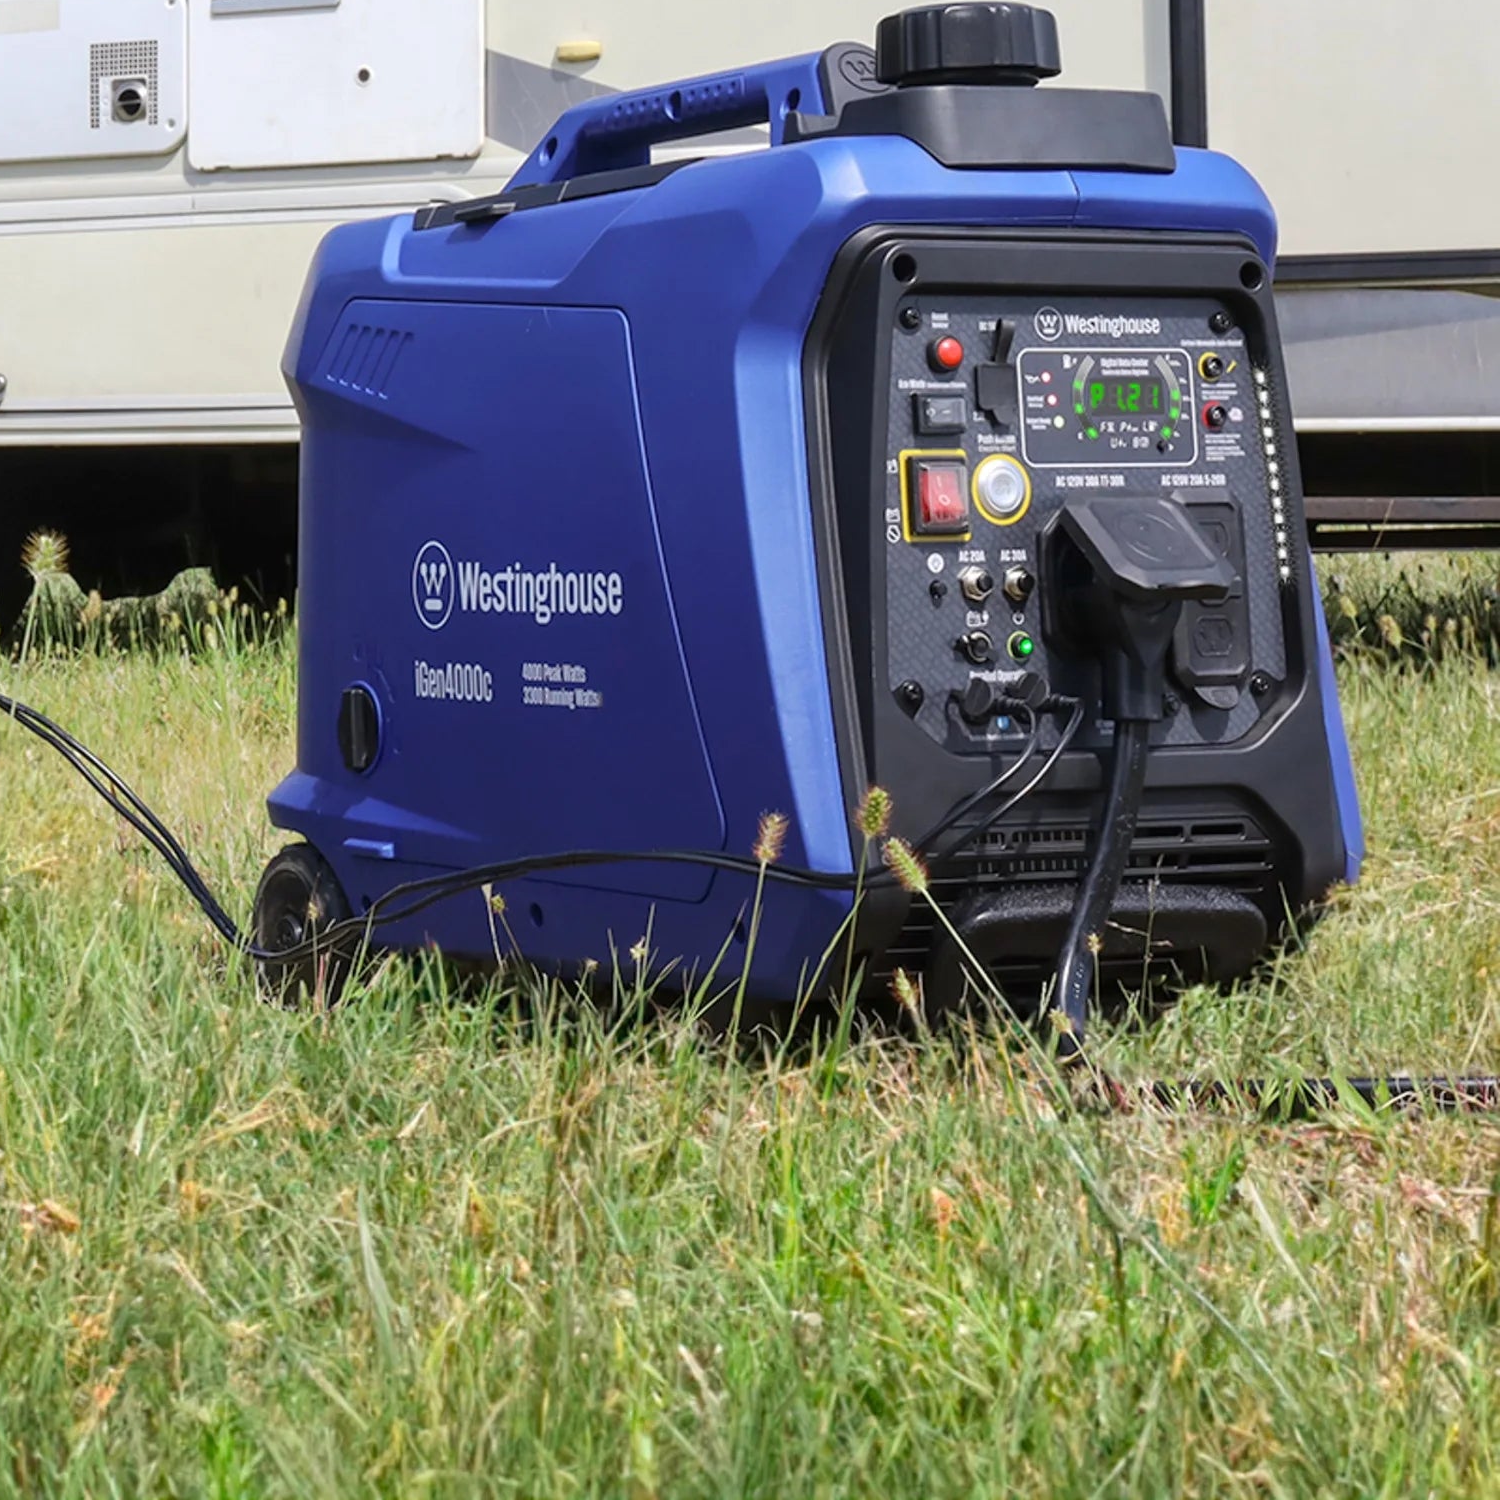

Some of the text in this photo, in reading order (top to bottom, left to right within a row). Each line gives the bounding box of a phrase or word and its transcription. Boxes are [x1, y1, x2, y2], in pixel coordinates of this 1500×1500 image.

[1064, 314, 1161, 338] Westinghouse
[1055, 474, 1067, 488] AC
[1161, 473, 1173, 486] AC
[958, 550, 969, 563] AC
[1000, 549, 1011, 562] AC
[457, 562, 623, 625] Westinghouse
[543, 663, 563, 682] Peak
[563, 664, 587, 684] Watts
